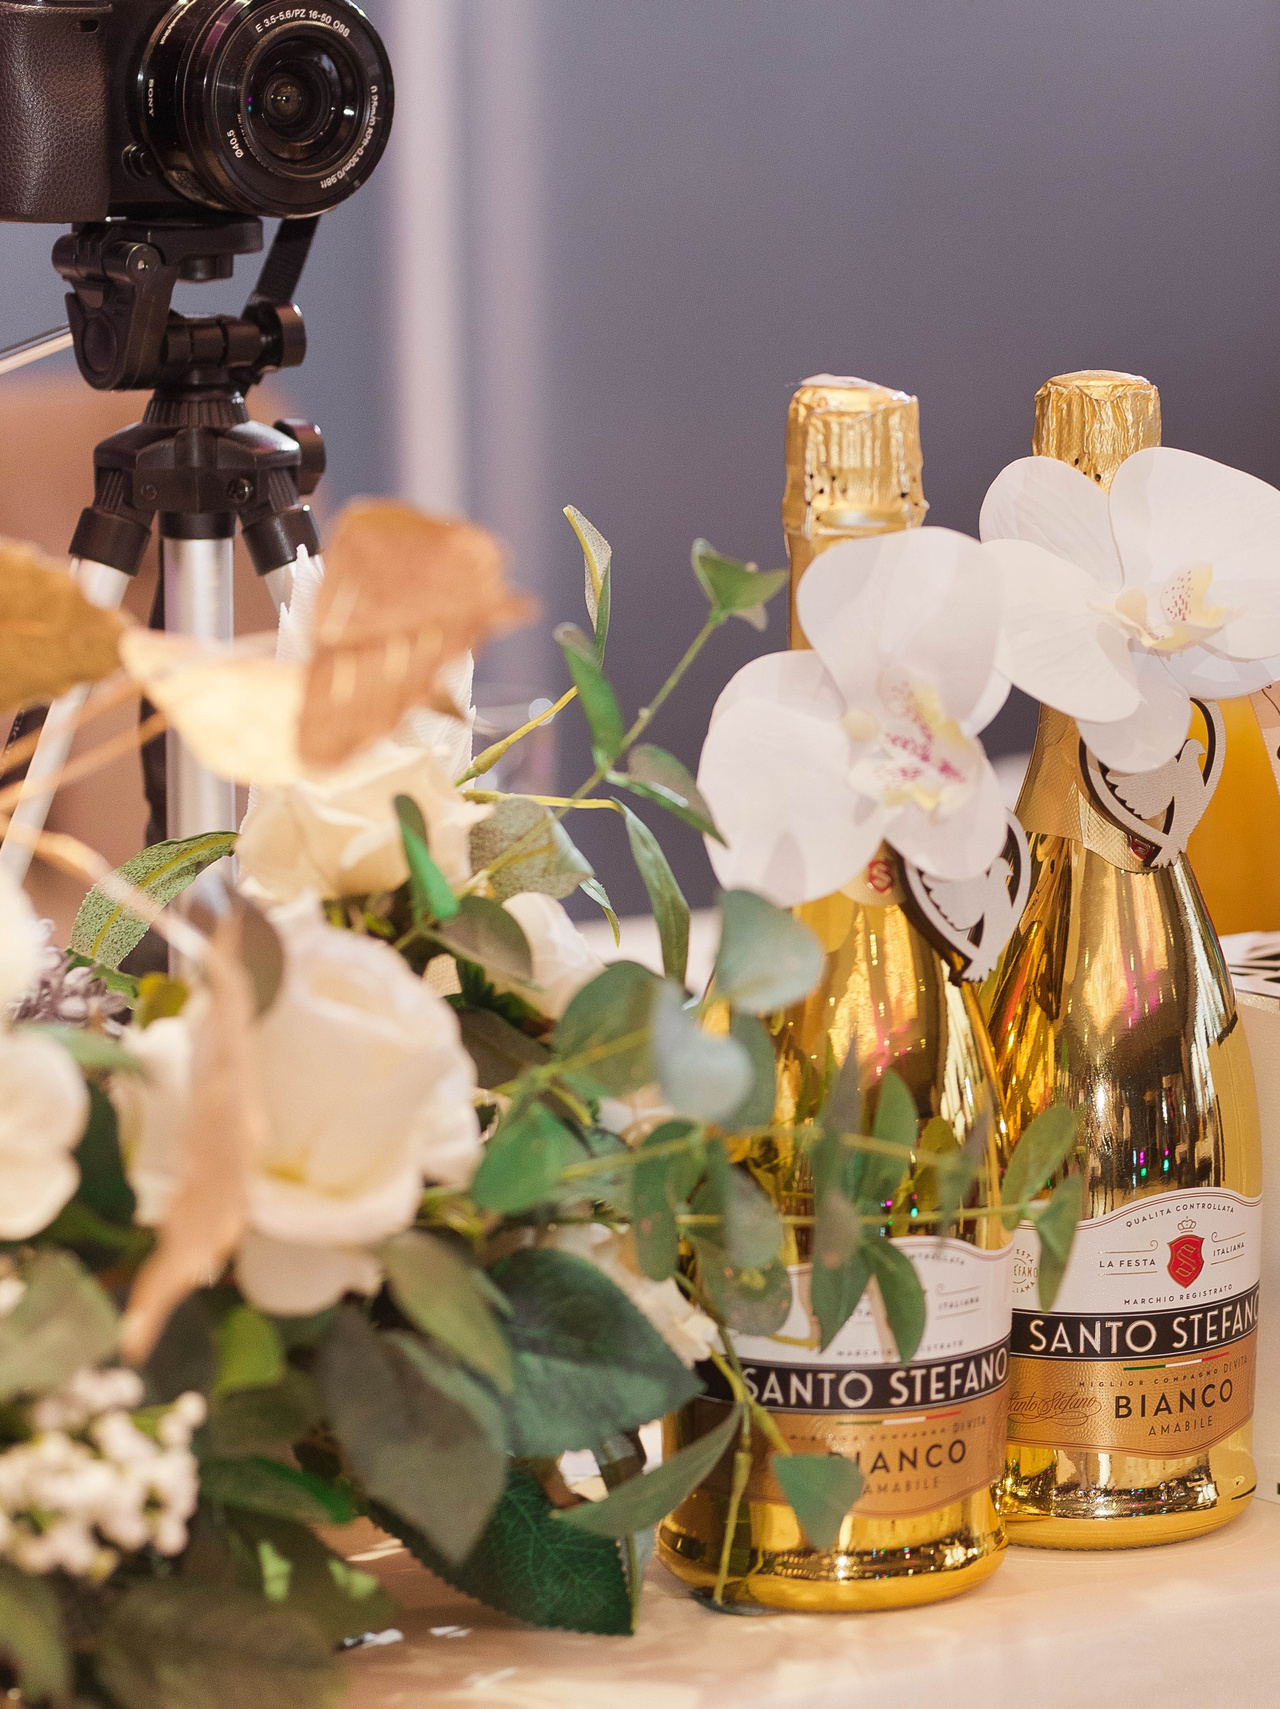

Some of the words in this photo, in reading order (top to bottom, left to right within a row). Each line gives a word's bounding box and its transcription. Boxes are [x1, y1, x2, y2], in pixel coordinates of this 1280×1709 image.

[255, 23, 264, 33] E
[308, 9, 332, 24] 16-50
[147, 78, 155, 118] SONY
[226, 129, 244, 158] Ø40.5
[1126, 1210, 1172, 1228] QUALITA
[1175, 1202, 1235, 1213] CONTROLLATA
[1213, 1242, 1245, 1257] ITALIANA
[1099, 1260, 1114, 1268] LA
[1119, 1258, 1156, 1267] FESTA
[1124, 1295, 1175, 1305] MARCHIO
[1179, 1283, 1233, 1301] REGISTRATO
[1029, 1319, 1158, 1355] SANTO
[742, 1367, 874, 1409] SANTO
[889, 1352, 1007, 1405] STEFANO
[1153, 1368, 1218, 1385] COMPAGNO
[1115, 1378, 1233, 1419] BIANCO
[1148, 1415, 1213, 1436] AMABILE
[829, 1439, 966, 1475] IANCO
